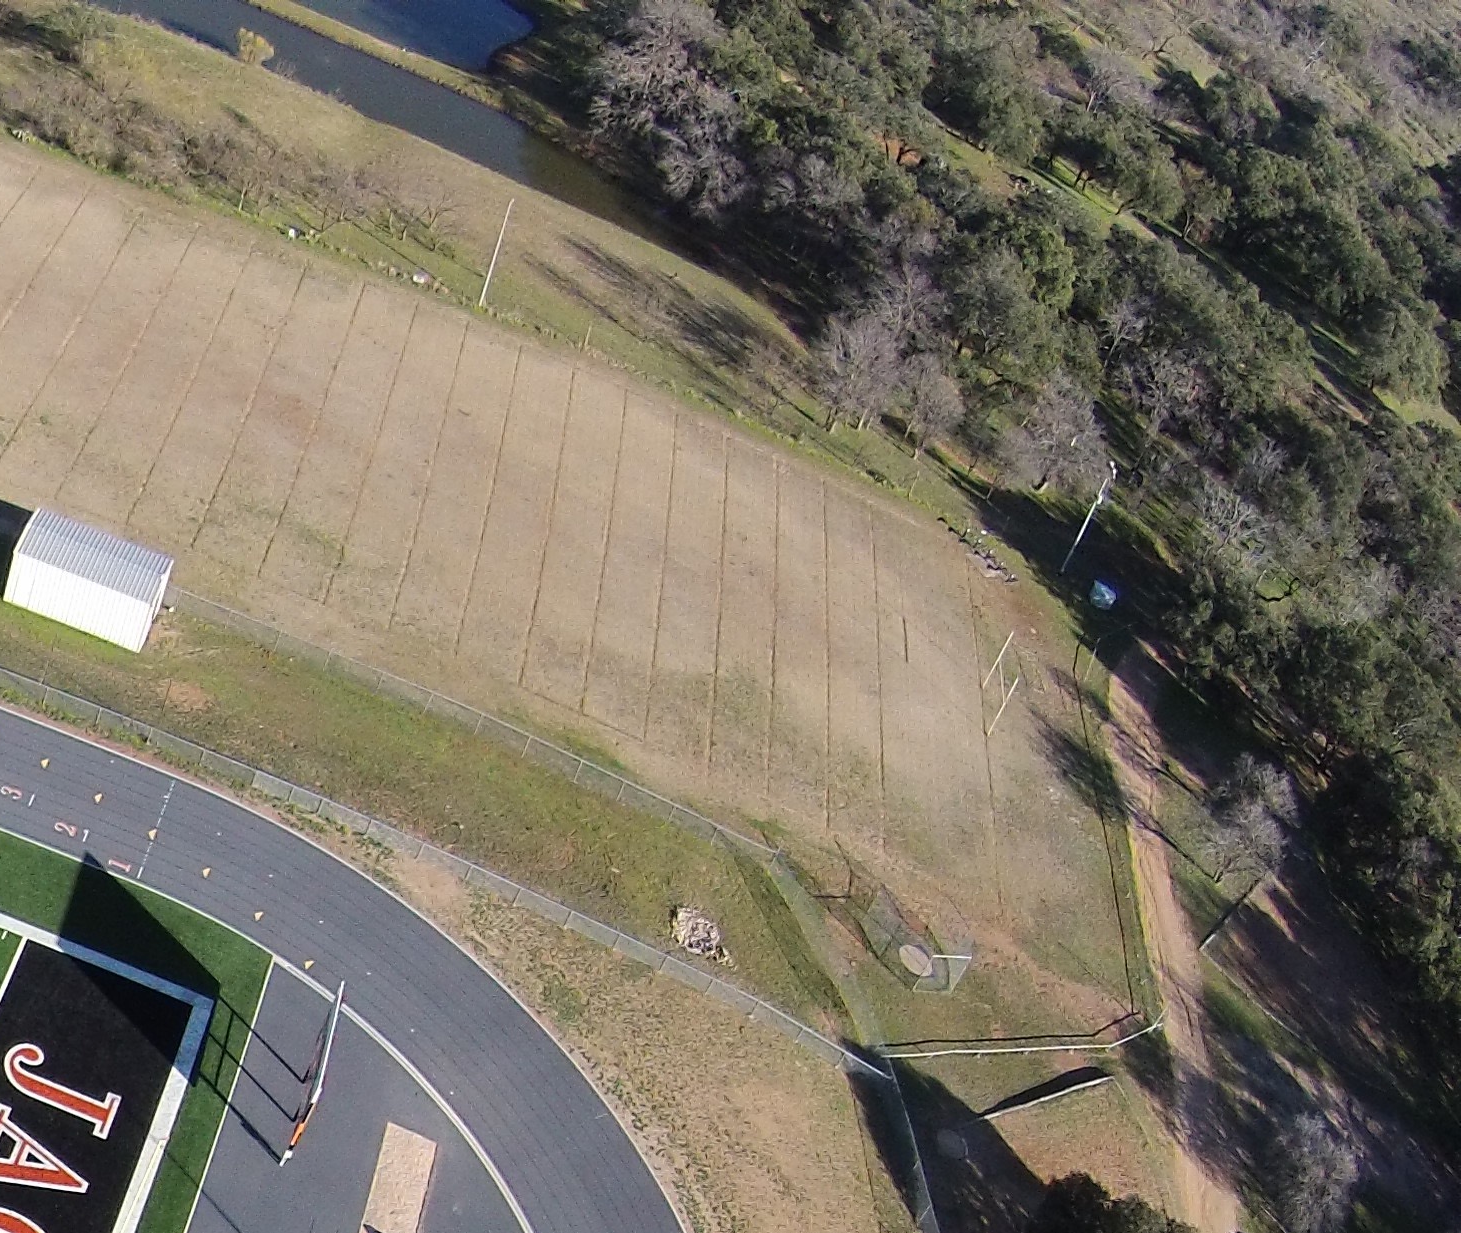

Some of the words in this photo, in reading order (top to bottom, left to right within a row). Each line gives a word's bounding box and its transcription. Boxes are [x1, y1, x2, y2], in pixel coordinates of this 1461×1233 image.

[0, 785, 23, 800] 3
[54, 821, 77, 838] 2
[108, 858, 132, 874] 1
